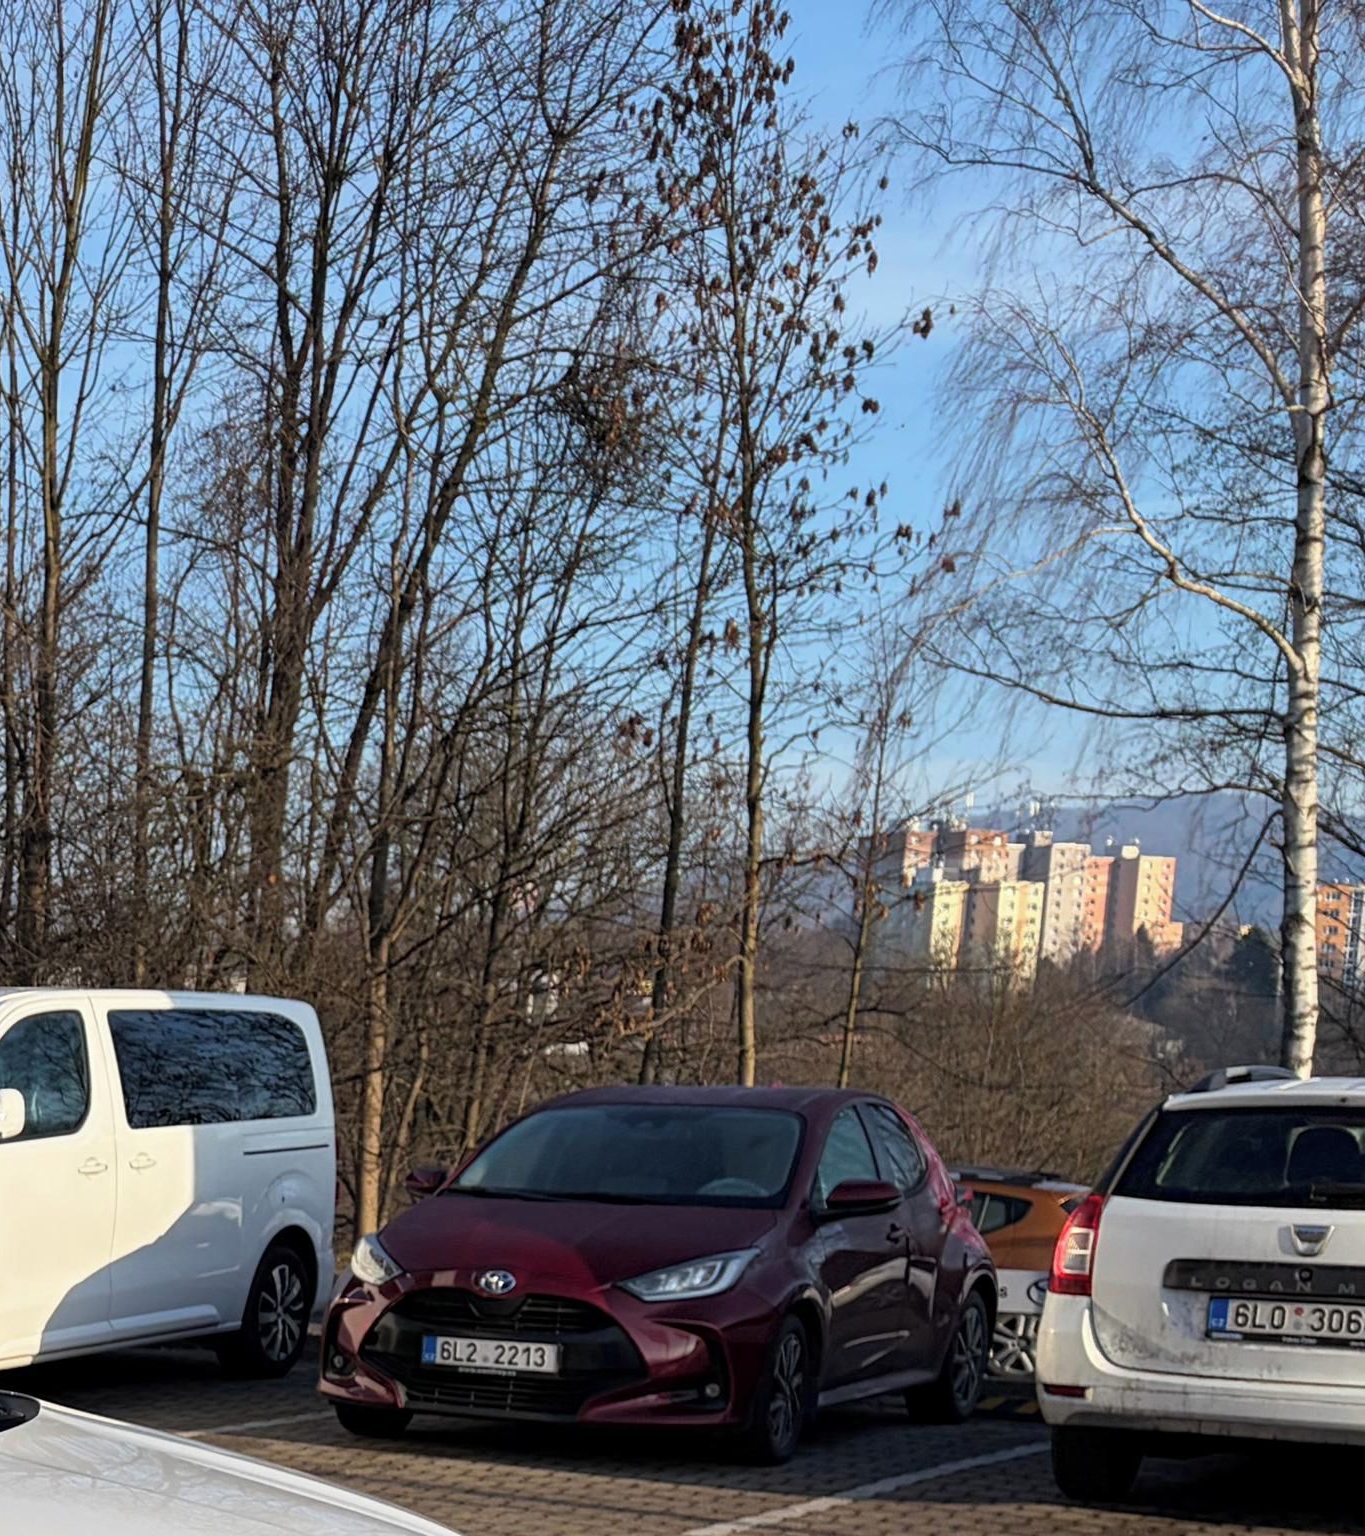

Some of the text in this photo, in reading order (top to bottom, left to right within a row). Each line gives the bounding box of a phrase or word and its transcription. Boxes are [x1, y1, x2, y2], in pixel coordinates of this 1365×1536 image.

[1190, 1276, 1312, 1293] LOGAN
[1235, 1303, 1365, 1334] 6L0 306
[440, 1340, 547, 1367] 6L2 2213
